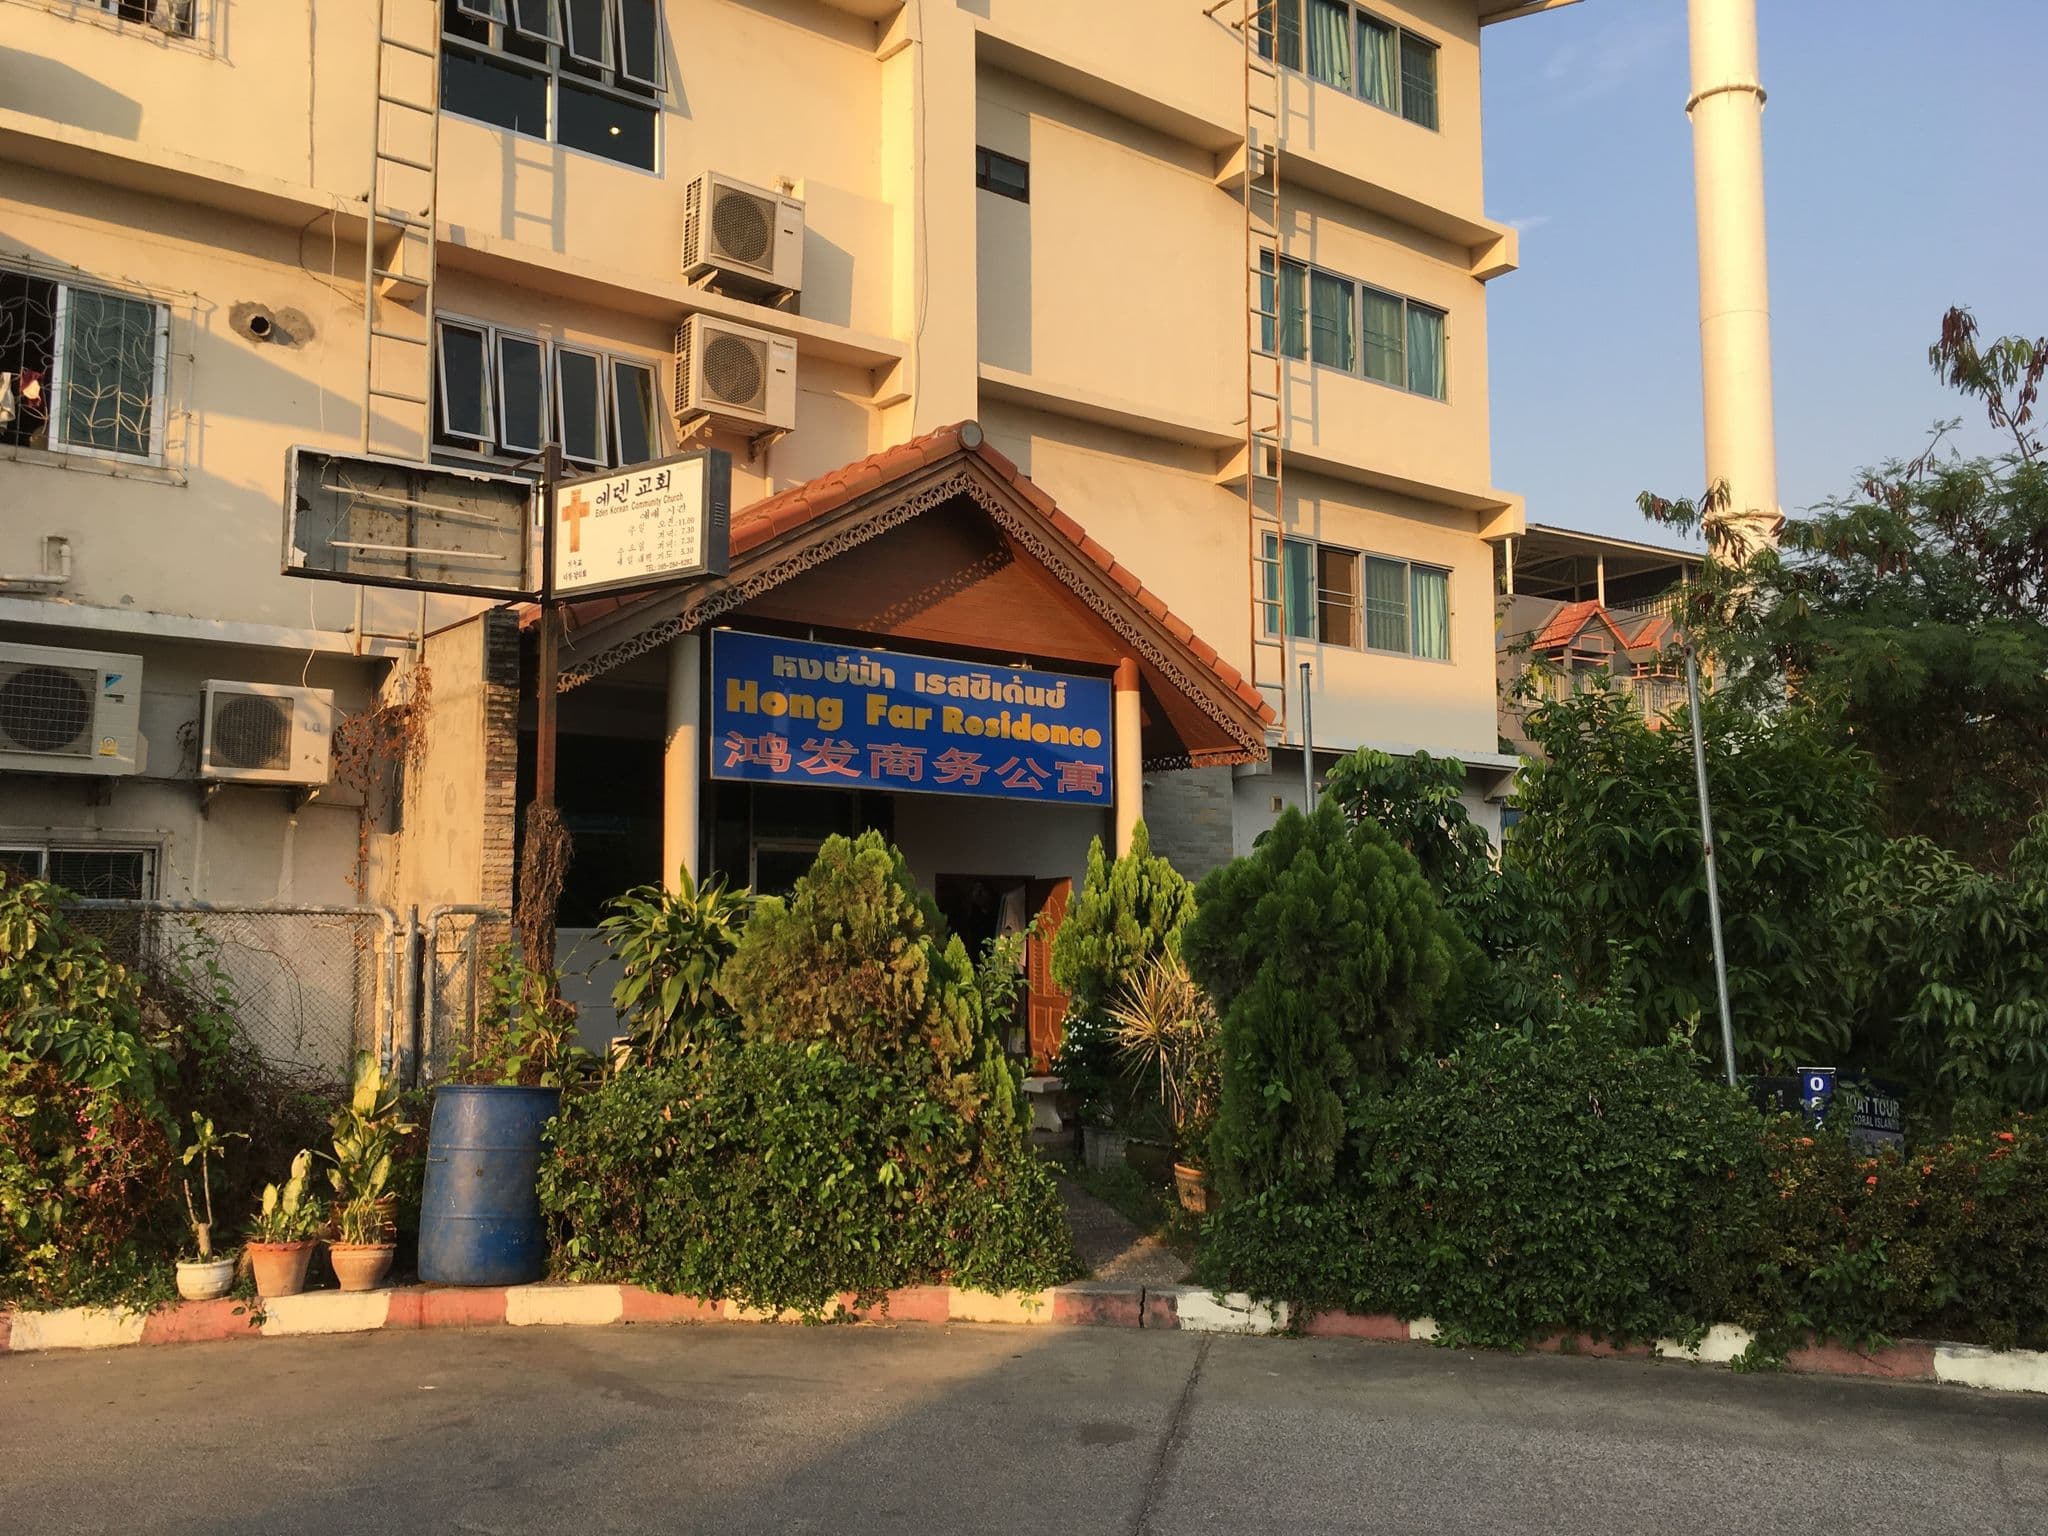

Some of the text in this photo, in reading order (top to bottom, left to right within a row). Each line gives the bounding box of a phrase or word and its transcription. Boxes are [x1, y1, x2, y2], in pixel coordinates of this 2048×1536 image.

[595, 469, 671, 506] 에덴 교회
[594, 492, 684, 518] Eden Korean Community Church
[726, 677, 1102, 749] Hong Far Residence
[723, 730, 1104, 797] 鸿发商务公寓
[1846, 1094, 1900, 1119] OAT TOUR
[1853, 1114, 1874, 1127] CORAL
